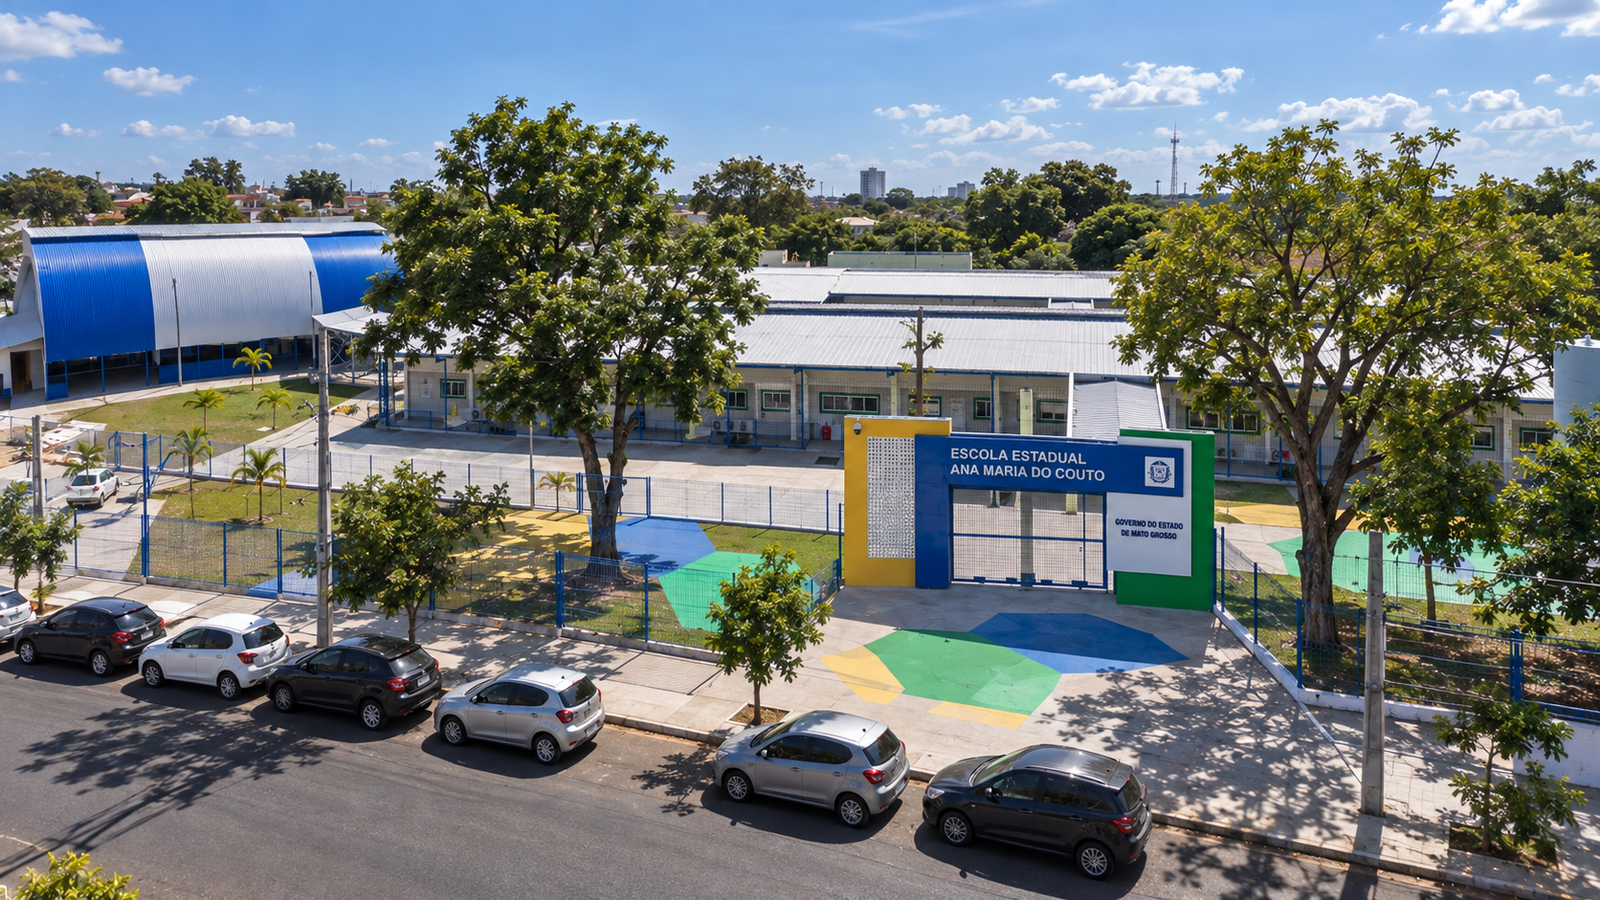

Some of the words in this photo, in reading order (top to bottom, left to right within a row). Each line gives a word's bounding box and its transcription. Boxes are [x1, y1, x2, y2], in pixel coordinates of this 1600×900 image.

[951, 448, 1008, 460] ESCOLA
[1012, 451, 1086, 465] ESTADUAL
[950, 464, 979, 475] ANA
[983, 465, 1027, 478] MARIA
[1031, 467, 1052, 478] DO
[1055, 468, 1105, 482] COUTO
[1115, 518, 1146, 528] GOVERNO
[1158, 521, 1183, 530] ESTADO
[1121, 529, 1130, 537] DE
[1131, 530, 1149, 538] MATO
[1150, 531, 1177, 540] GROSSO
